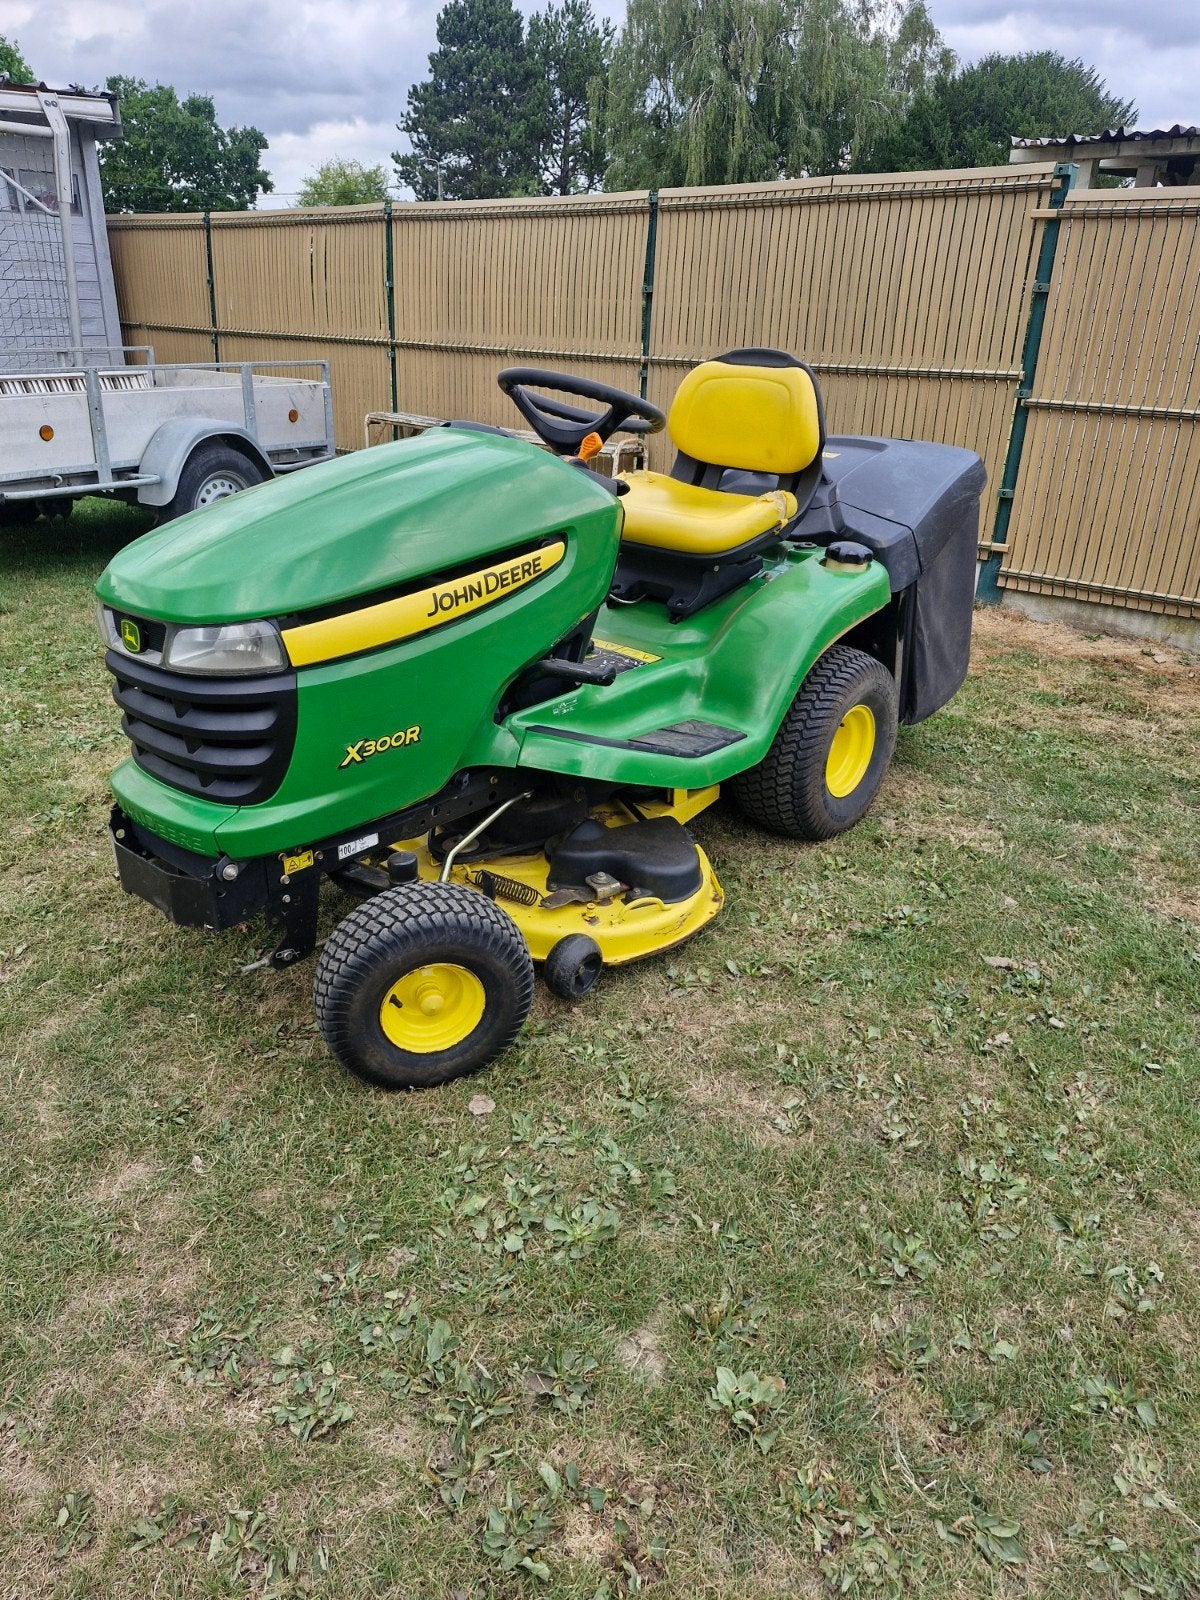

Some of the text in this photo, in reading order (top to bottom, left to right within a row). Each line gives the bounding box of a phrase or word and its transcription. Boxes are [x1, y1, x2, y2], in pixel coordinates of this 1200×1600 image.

[427, 556, 543, 617] JOHN DEERE
[339, 725, 421, 768] X300R
